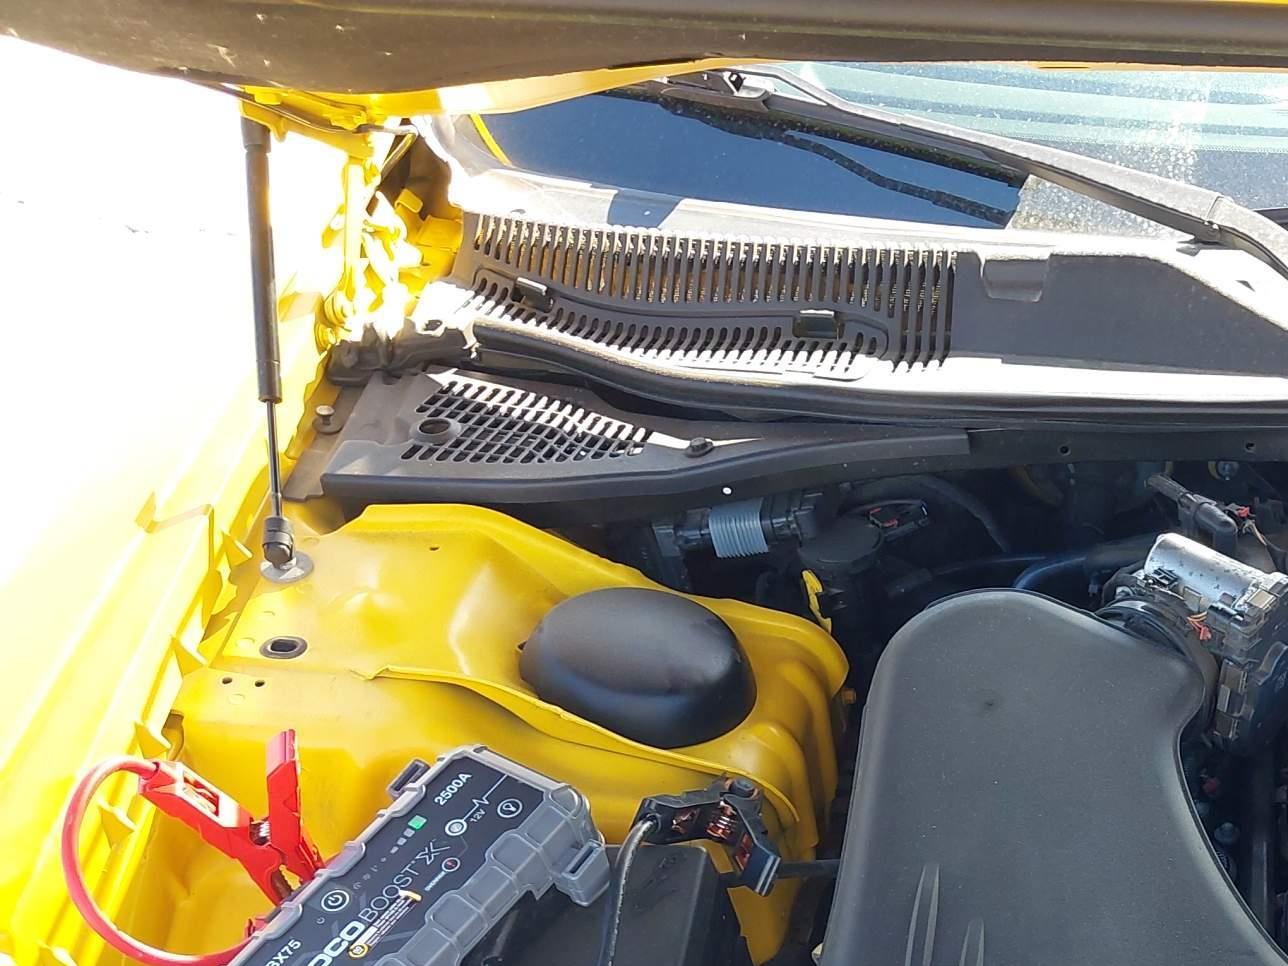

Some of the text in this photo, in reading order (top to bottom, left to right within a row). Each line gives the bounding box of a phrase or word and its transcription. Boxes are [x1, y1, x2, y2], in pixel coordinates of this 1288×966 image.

[434, 773, 473, 806] 2500A
[469, 808, 486, 823] 12V
[358, 863, 420, 923] BOOST
